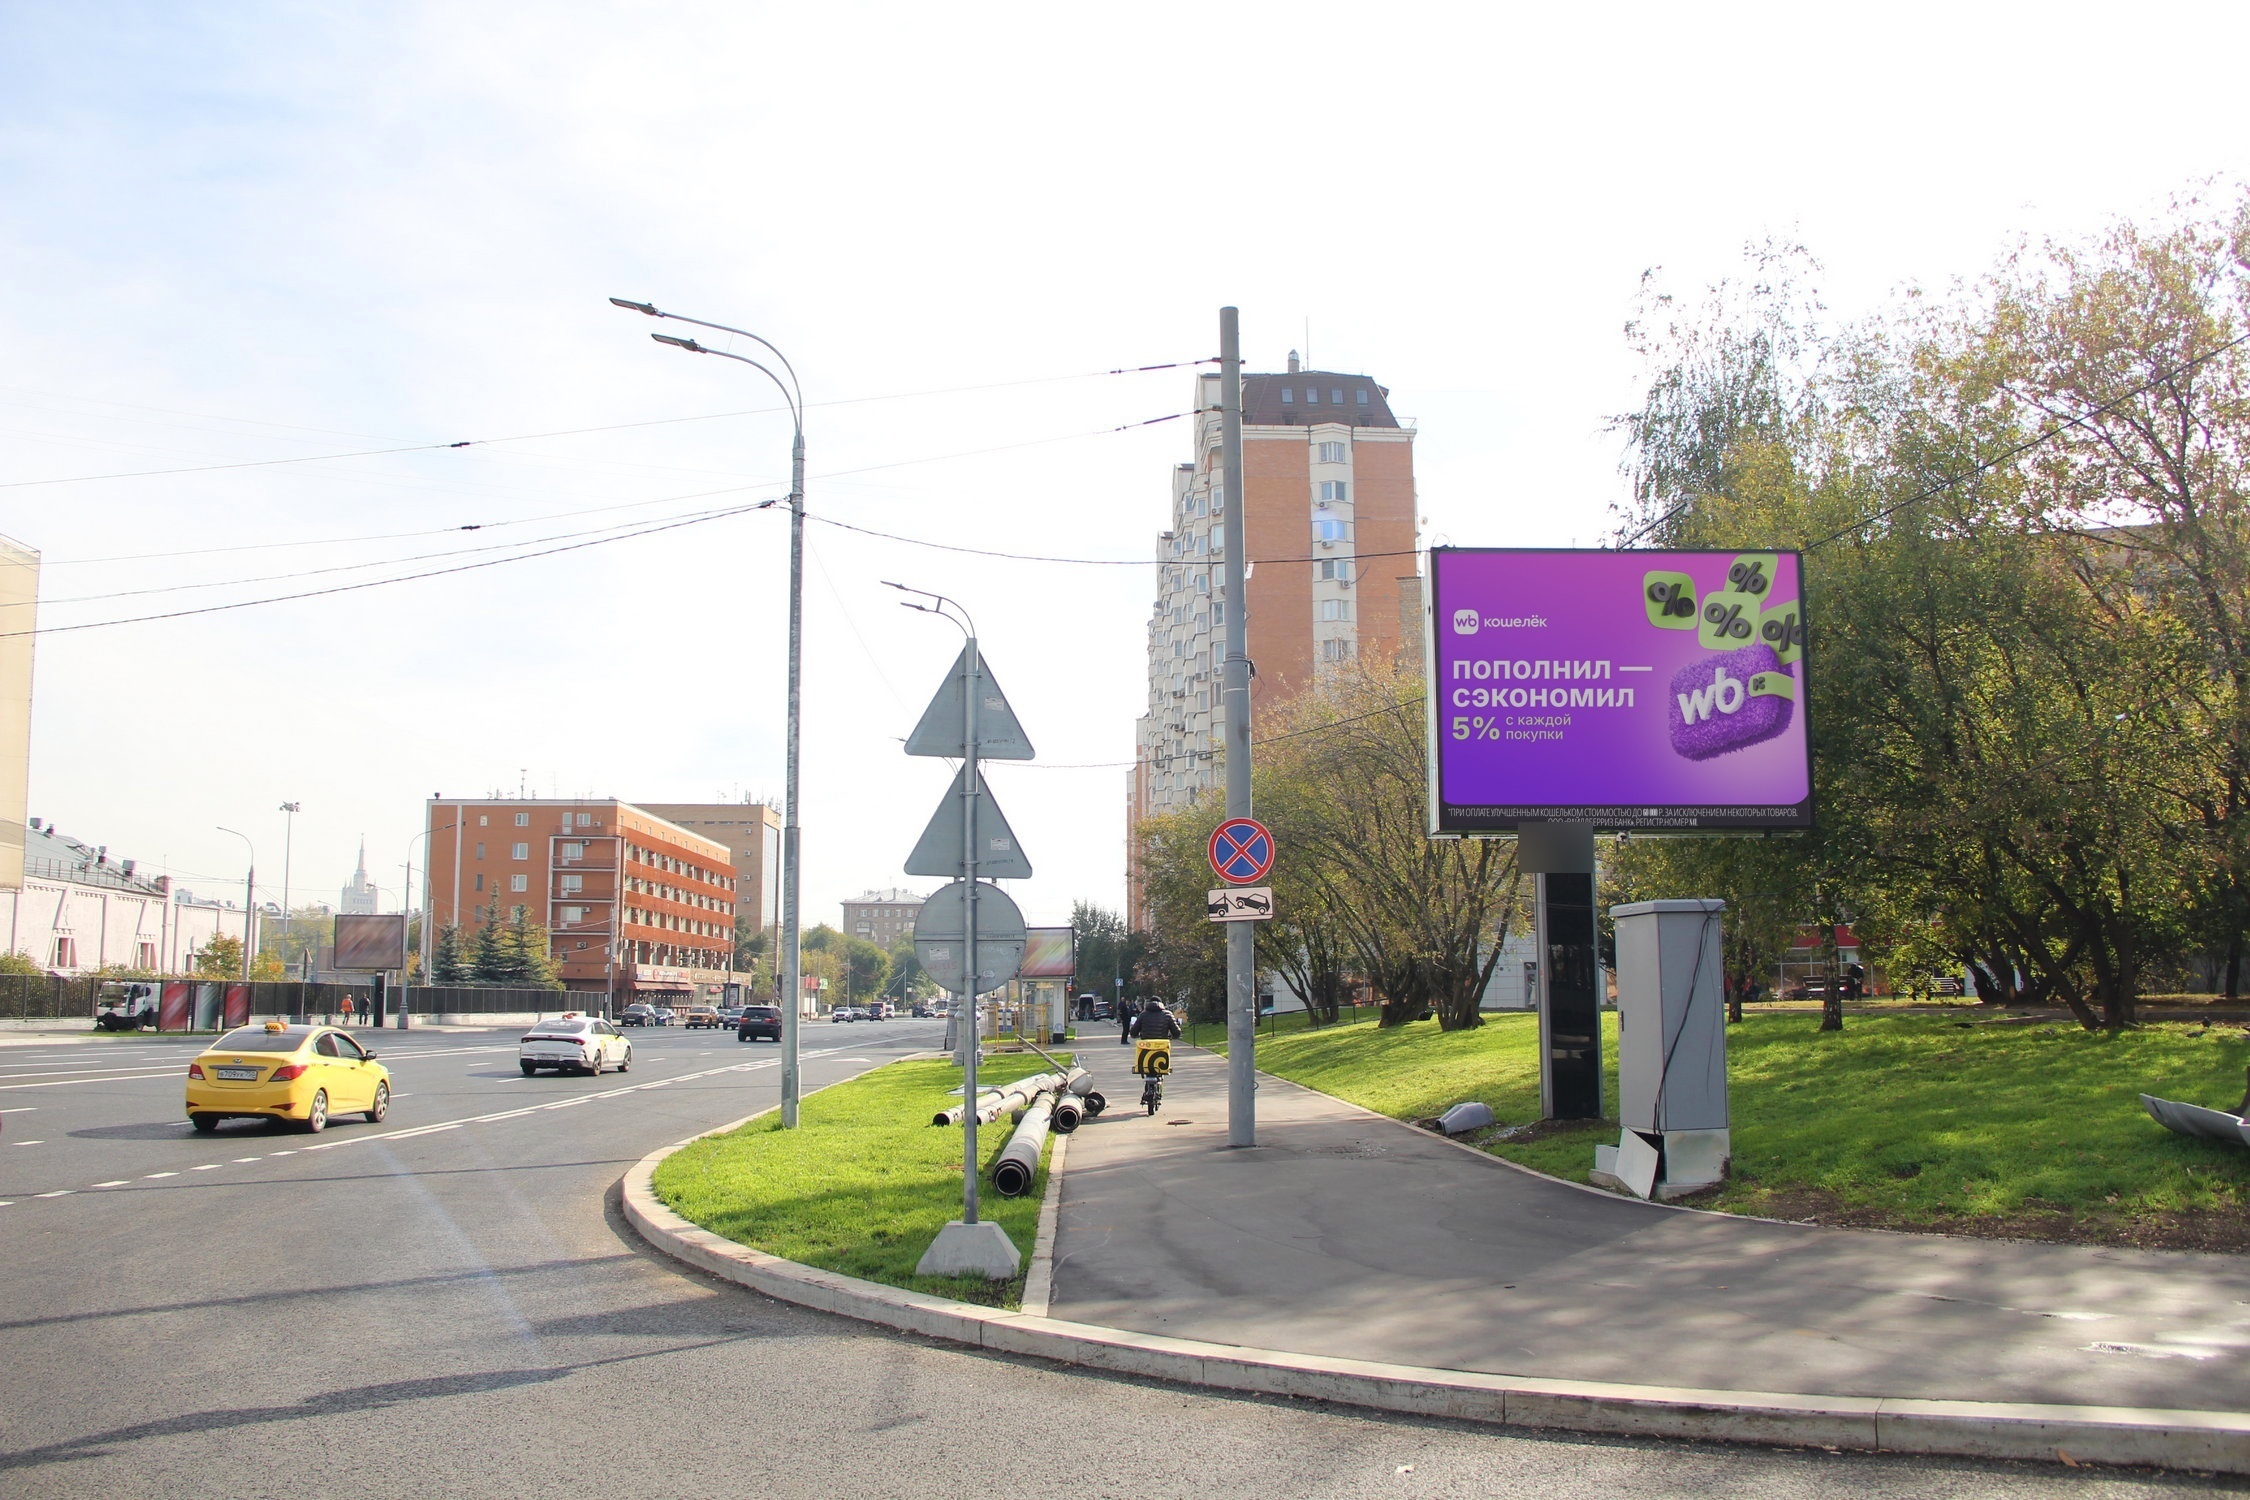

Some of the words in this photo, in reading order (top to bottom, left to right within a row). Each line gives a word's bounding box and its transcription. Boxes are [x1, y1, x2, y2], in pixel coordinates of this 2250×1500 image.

[1484, 614, 1547, 628] кошелёк
[1677, 667, 1745, 725] wb
[1452, 716, 1501, 740] 5%
[1518, 714, 1571, 728] каждой
[1506, 730, 1563, 743] покупки
[1465, 807, 1490, 817] ОПЛАТЕ
[1490, 807, 1540, 817] УЛУЧШЕННЫМ
[1540, 807, 1583, 817] КОШЕЛЬКОМ
[1584, 807, 1632, 817] СТОИМОСТЬЮ
[1673, 807, 1727, 817] ИСКЛЮЧЕНИЕМ
